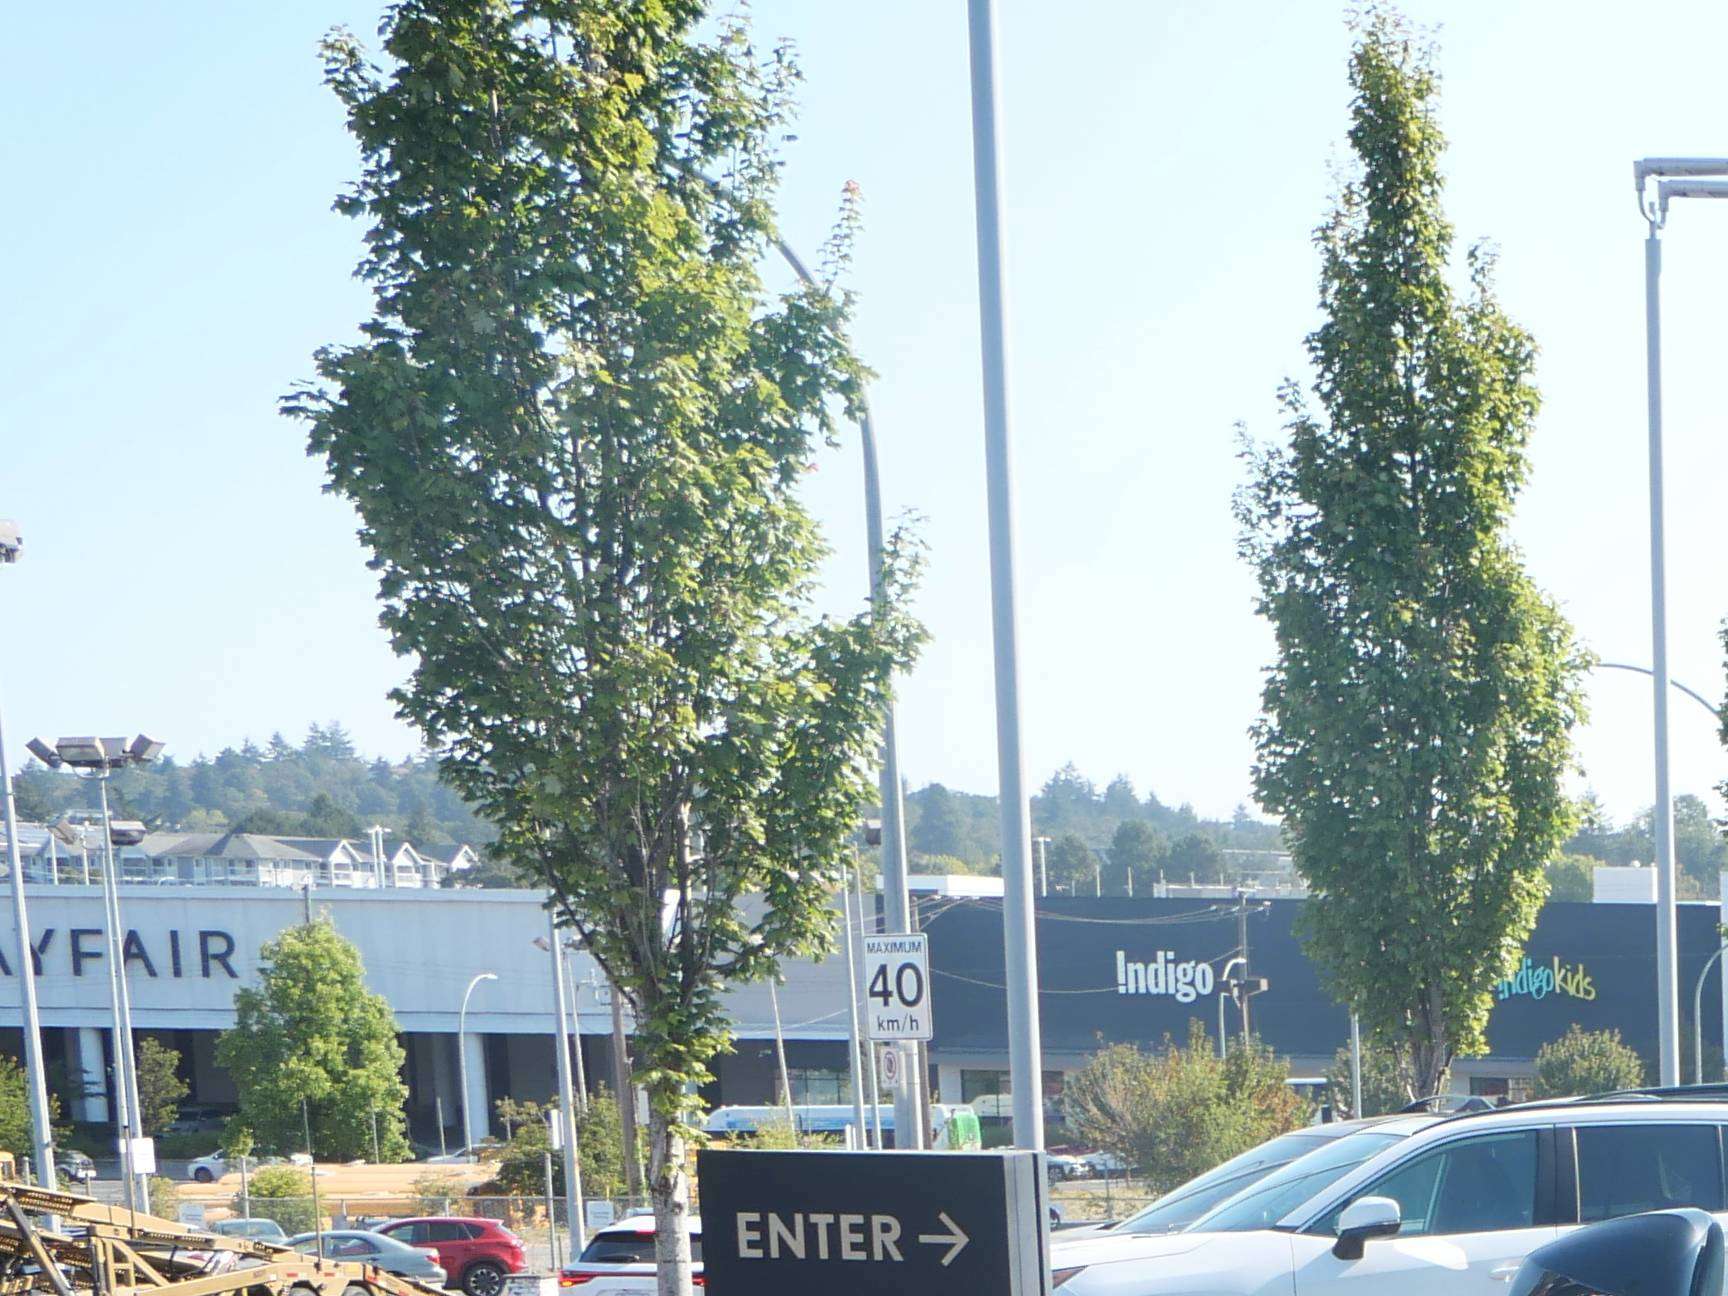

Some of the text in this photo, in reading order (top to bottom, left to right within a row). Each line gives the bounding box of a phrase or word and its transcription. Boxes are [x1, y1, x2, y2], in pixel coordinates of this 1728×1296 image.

[0, 928, 239, 979] YFAIR
[867, 941, 922, 954] MAXIMUM
[869, 962, 924, 1008] 40
[877, 1013, 919, 1032] km/h
[736, 1211, 904, 1262] ENTER
